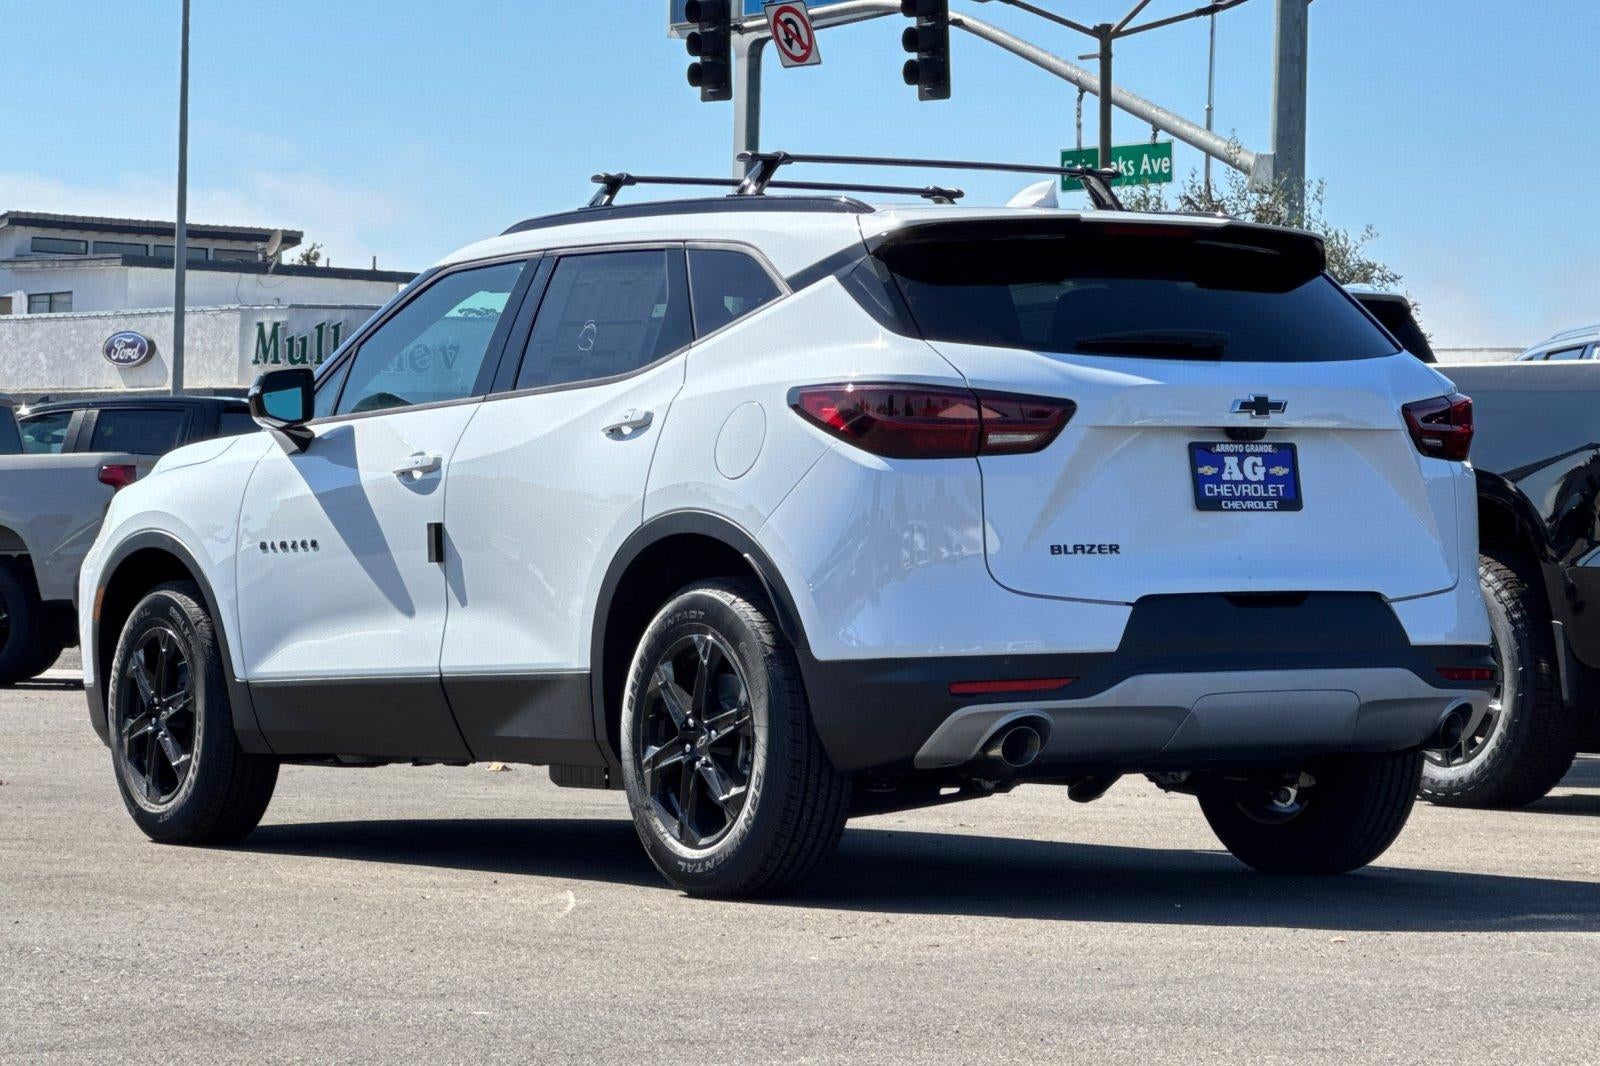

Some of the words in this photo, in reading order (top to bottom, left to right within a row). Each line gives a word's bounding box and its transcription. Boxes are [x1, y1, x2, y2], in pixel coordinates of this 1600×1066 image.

[1109, 156, 1135, 177] aks
[1139, 153, 1171, 176] Ave
[110, 337, 141, 360] Ford
[1215, 444, 1244, 453] ARROYO
[1245, 444, 1273, 453] GRANDE
[1221, 456, 1266, 482] AG
[1204, 483, 1285, 497] CHEVROLET
[1221, 500, 1279, 509] CHEVROLET
[1050, 544, 1121, 555] BLAZER
